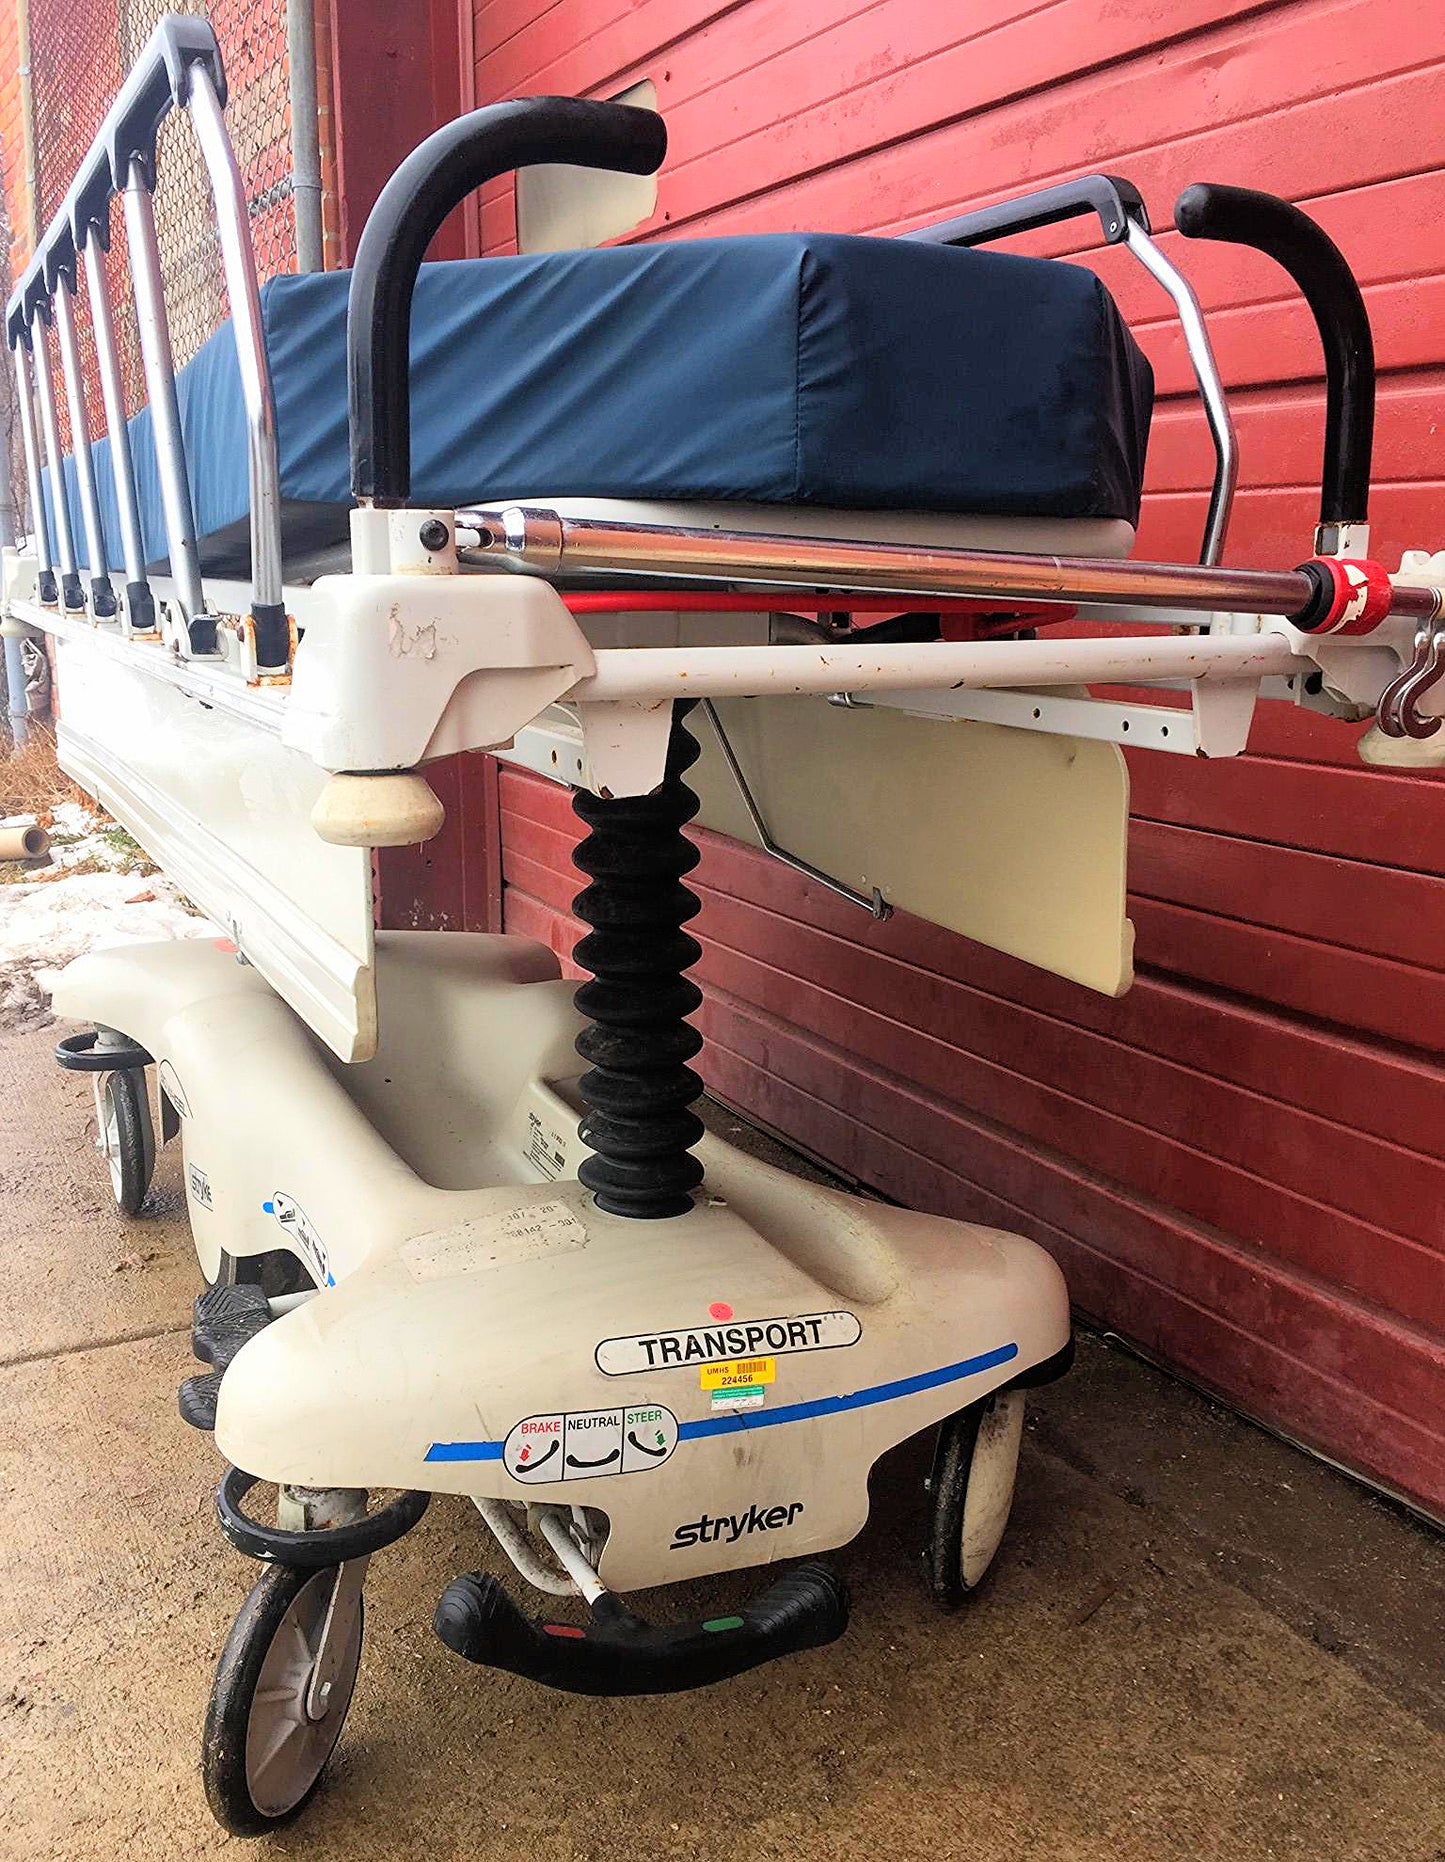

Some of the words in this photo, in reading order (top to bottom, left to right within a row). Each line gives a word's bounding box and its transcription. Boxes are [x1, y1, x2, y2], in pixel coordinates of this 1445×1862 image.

[638, 1318, 823, 1366] TRANSPORT
[706, 1366, 729, 1376] UMHS
[721, 1374, 754, 1386] 224456
[520, 1420, 561, 1435] BRAKE
[567, 1414, 621, 1432] NEUTRAL
[626, 1409, 663, 1425] STEER
[669, 1501, 804, 1551] stryker
